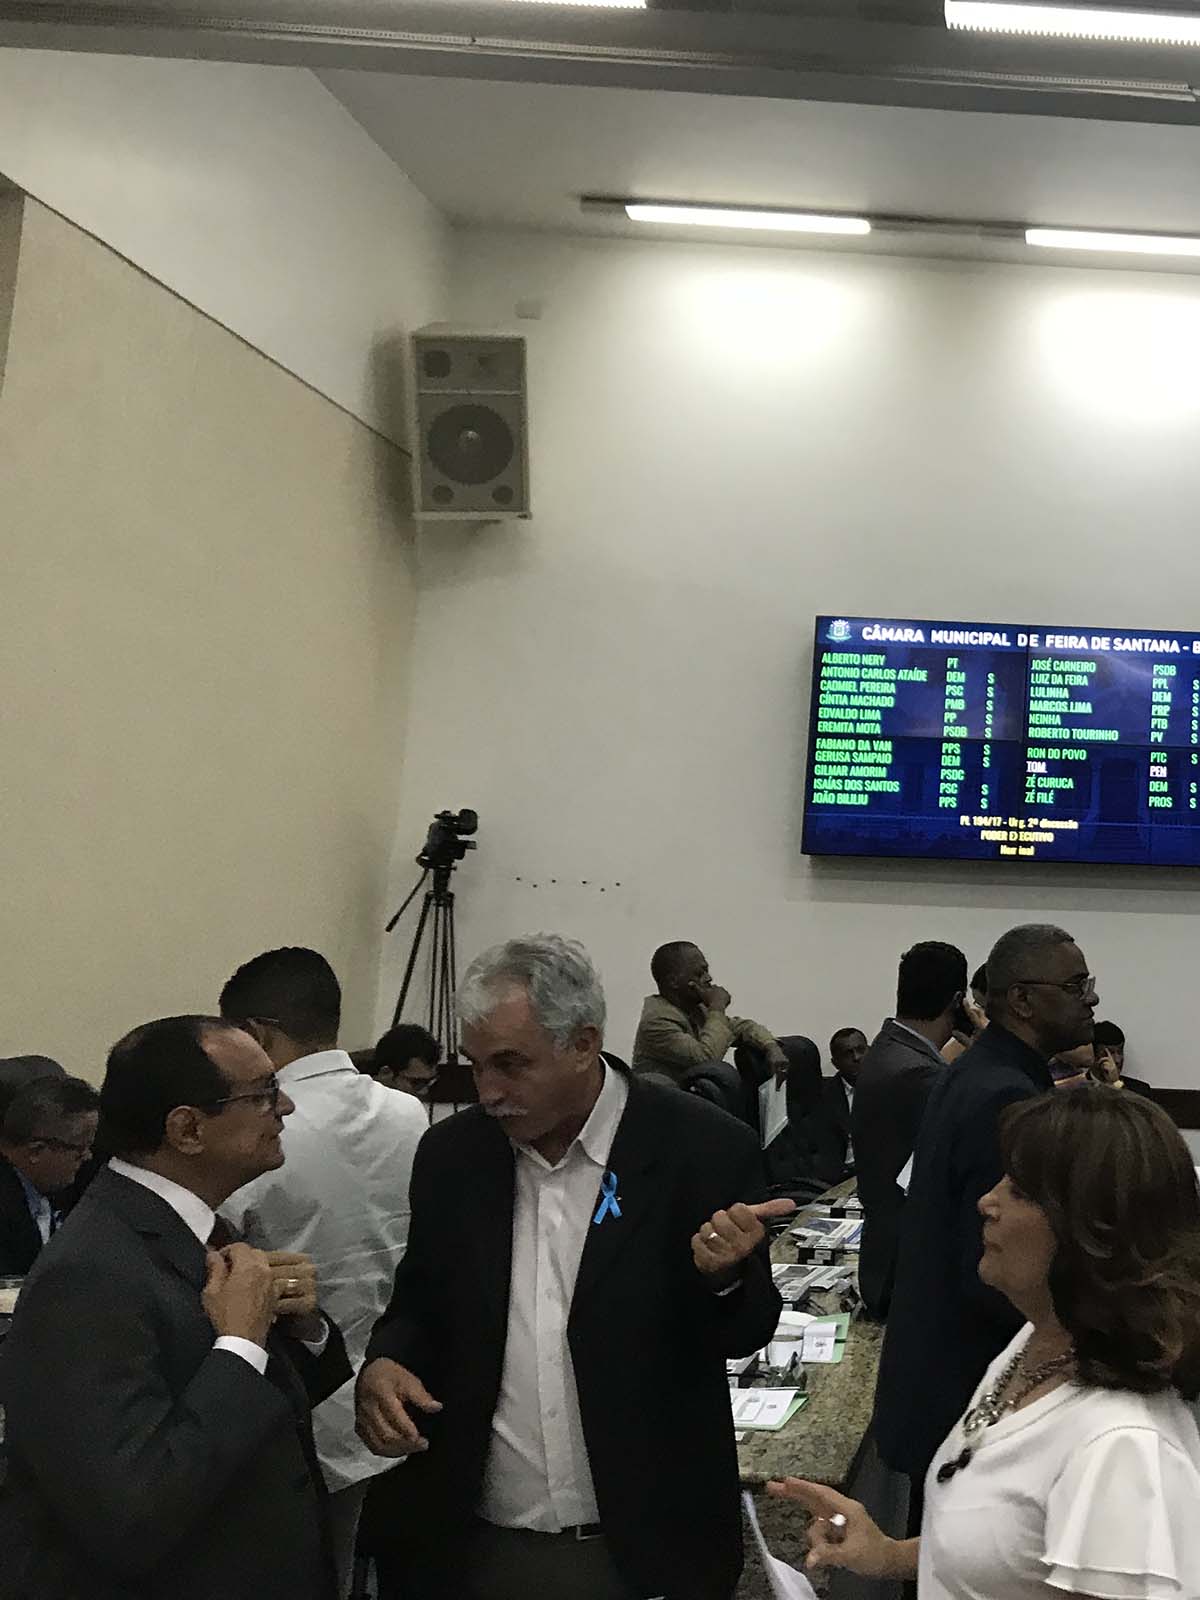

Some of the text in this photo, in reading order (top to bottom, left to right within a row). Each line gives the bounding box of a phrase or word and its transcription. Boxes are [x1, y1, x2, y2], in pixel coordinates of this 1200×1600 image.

[862, 624, 924, 643] CÂMARA
[931, 630, 1011, 646] MUNICIPAL
[1018, 634, 1038, 647] DE
[1046, 635, 1088, 649] FEIRA
[1091, 637, 1110, 650] DE
[1113, 638, 1180, 653] SANTANA
[822, 653, 958, 668] ALBERTO NERY PT
[1031, 658, 1176, 675] JOSÉ CARNEIRO PSDB
[821, 667, 995, 684] ANTONIO CARLOS ATAÍDE DEM S
[1031, 674, 1199, 690] LUIZ DA FEIRA PPL S
[820, 680, 994, 698] CADMIEL PEREIRA PSC S
[1030, 687, 1199, 703] LULINHA DEM S
[819, 691, 994, 711] CÍNTIA MACHADO PMB S
[1029, 701, 1068, 712] MARCOS
[1070, 702, 1092, 713] LIMA
[1192, 706, 1198, 717] S
[819, 708, 993, 724] EDVALDO LIMA PP S
[1029, 714, 1198, 730] NEINHA PTB S
[818, 721, 992, 738] EREMITA MOTA PSDB S
[1029, 728, 1198, 744] ROBERTO TOURINHO PV S
[816, 739, 990, 755] FABIANO DA VAN PPS S
[815, 751, 990, 768] GERUSA SAMPAIO DEM S
[1027, 748, 1198, 764] RON DO POVO PTC S
[815, 765, 964, 780] GILMAR AMORIM PSDC
[814, 777, 988, 795] ISAÍAS DOS SANTOS PSC S
[1025, 775, 1197, 793] ZÉ CURUCA DEM S
[812, 792, 835, 804] JOÃO
[939, 797, 957, 808] PPS
[981, 798, 987, 809] S
[1025, 790, 1196, 808] ZÉ FILÉ PROS S
